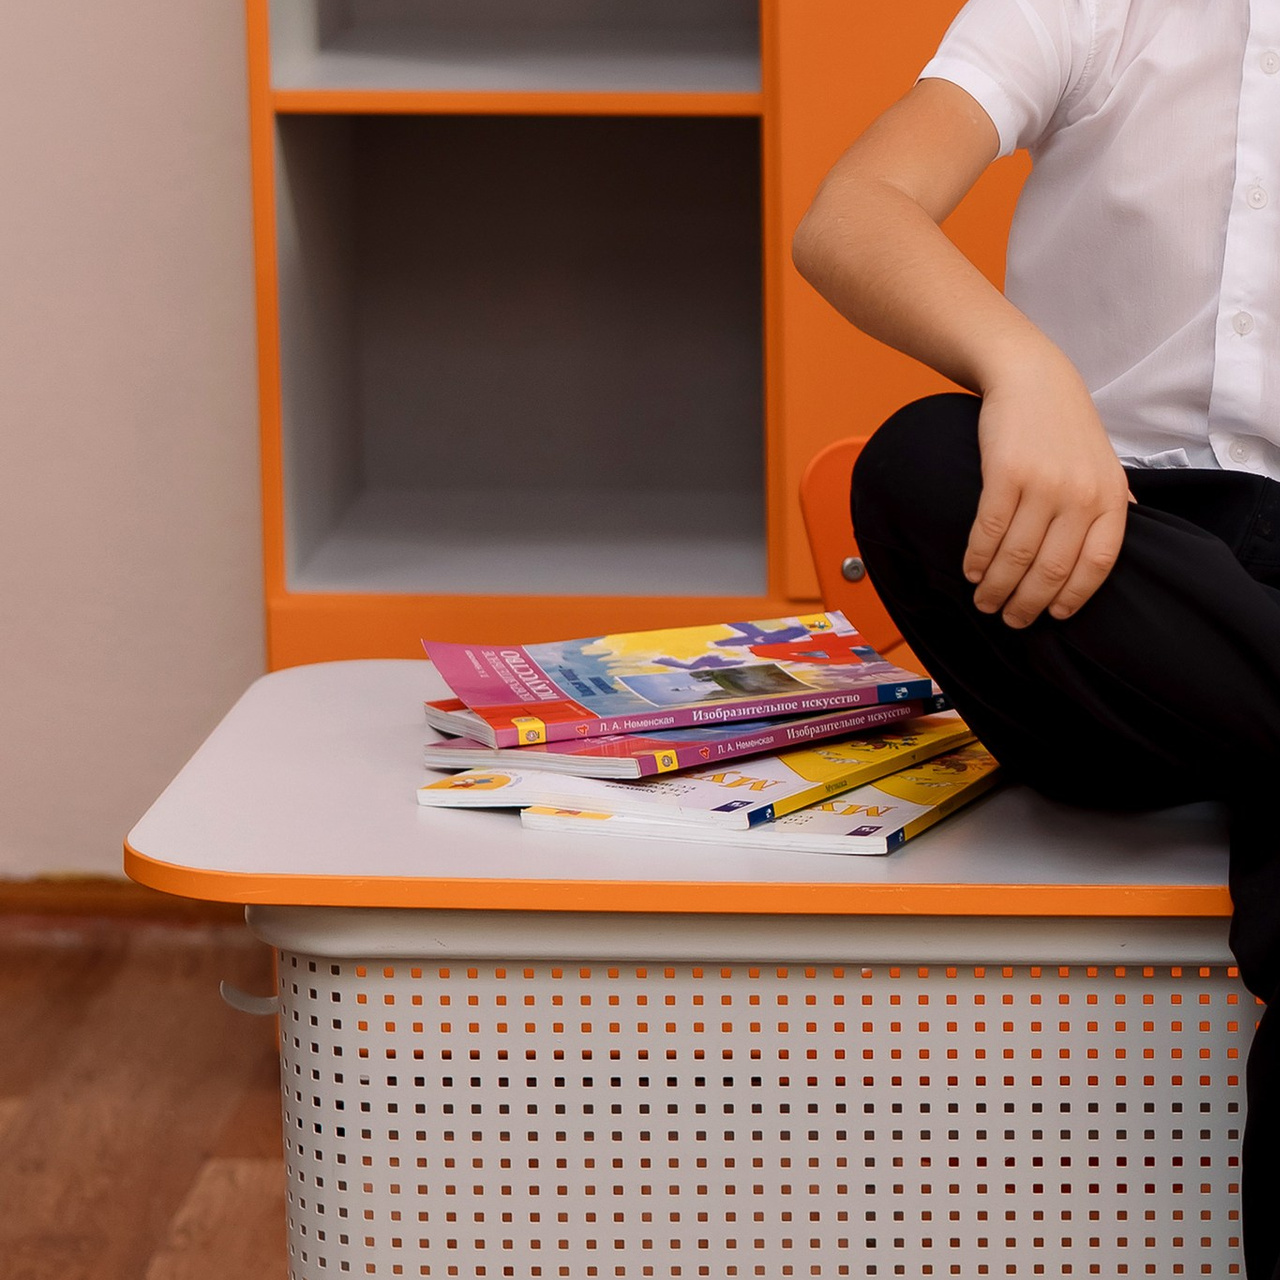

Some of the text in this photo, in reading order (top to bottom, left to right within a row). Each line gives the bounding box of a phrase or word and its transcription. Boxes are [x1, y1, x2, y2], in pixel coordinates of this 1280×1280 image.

[612, 721, 622, 731] А.
[692, 700, 798, 722] Изобразительное
[801, 692, 861, 709] искусство
[727, 742, 735, 752] А.
[736, 734, 774, 750] Неменская
[786, 716, 866, 740] Изобразительное
[868, 705, 911, 724] искусство
